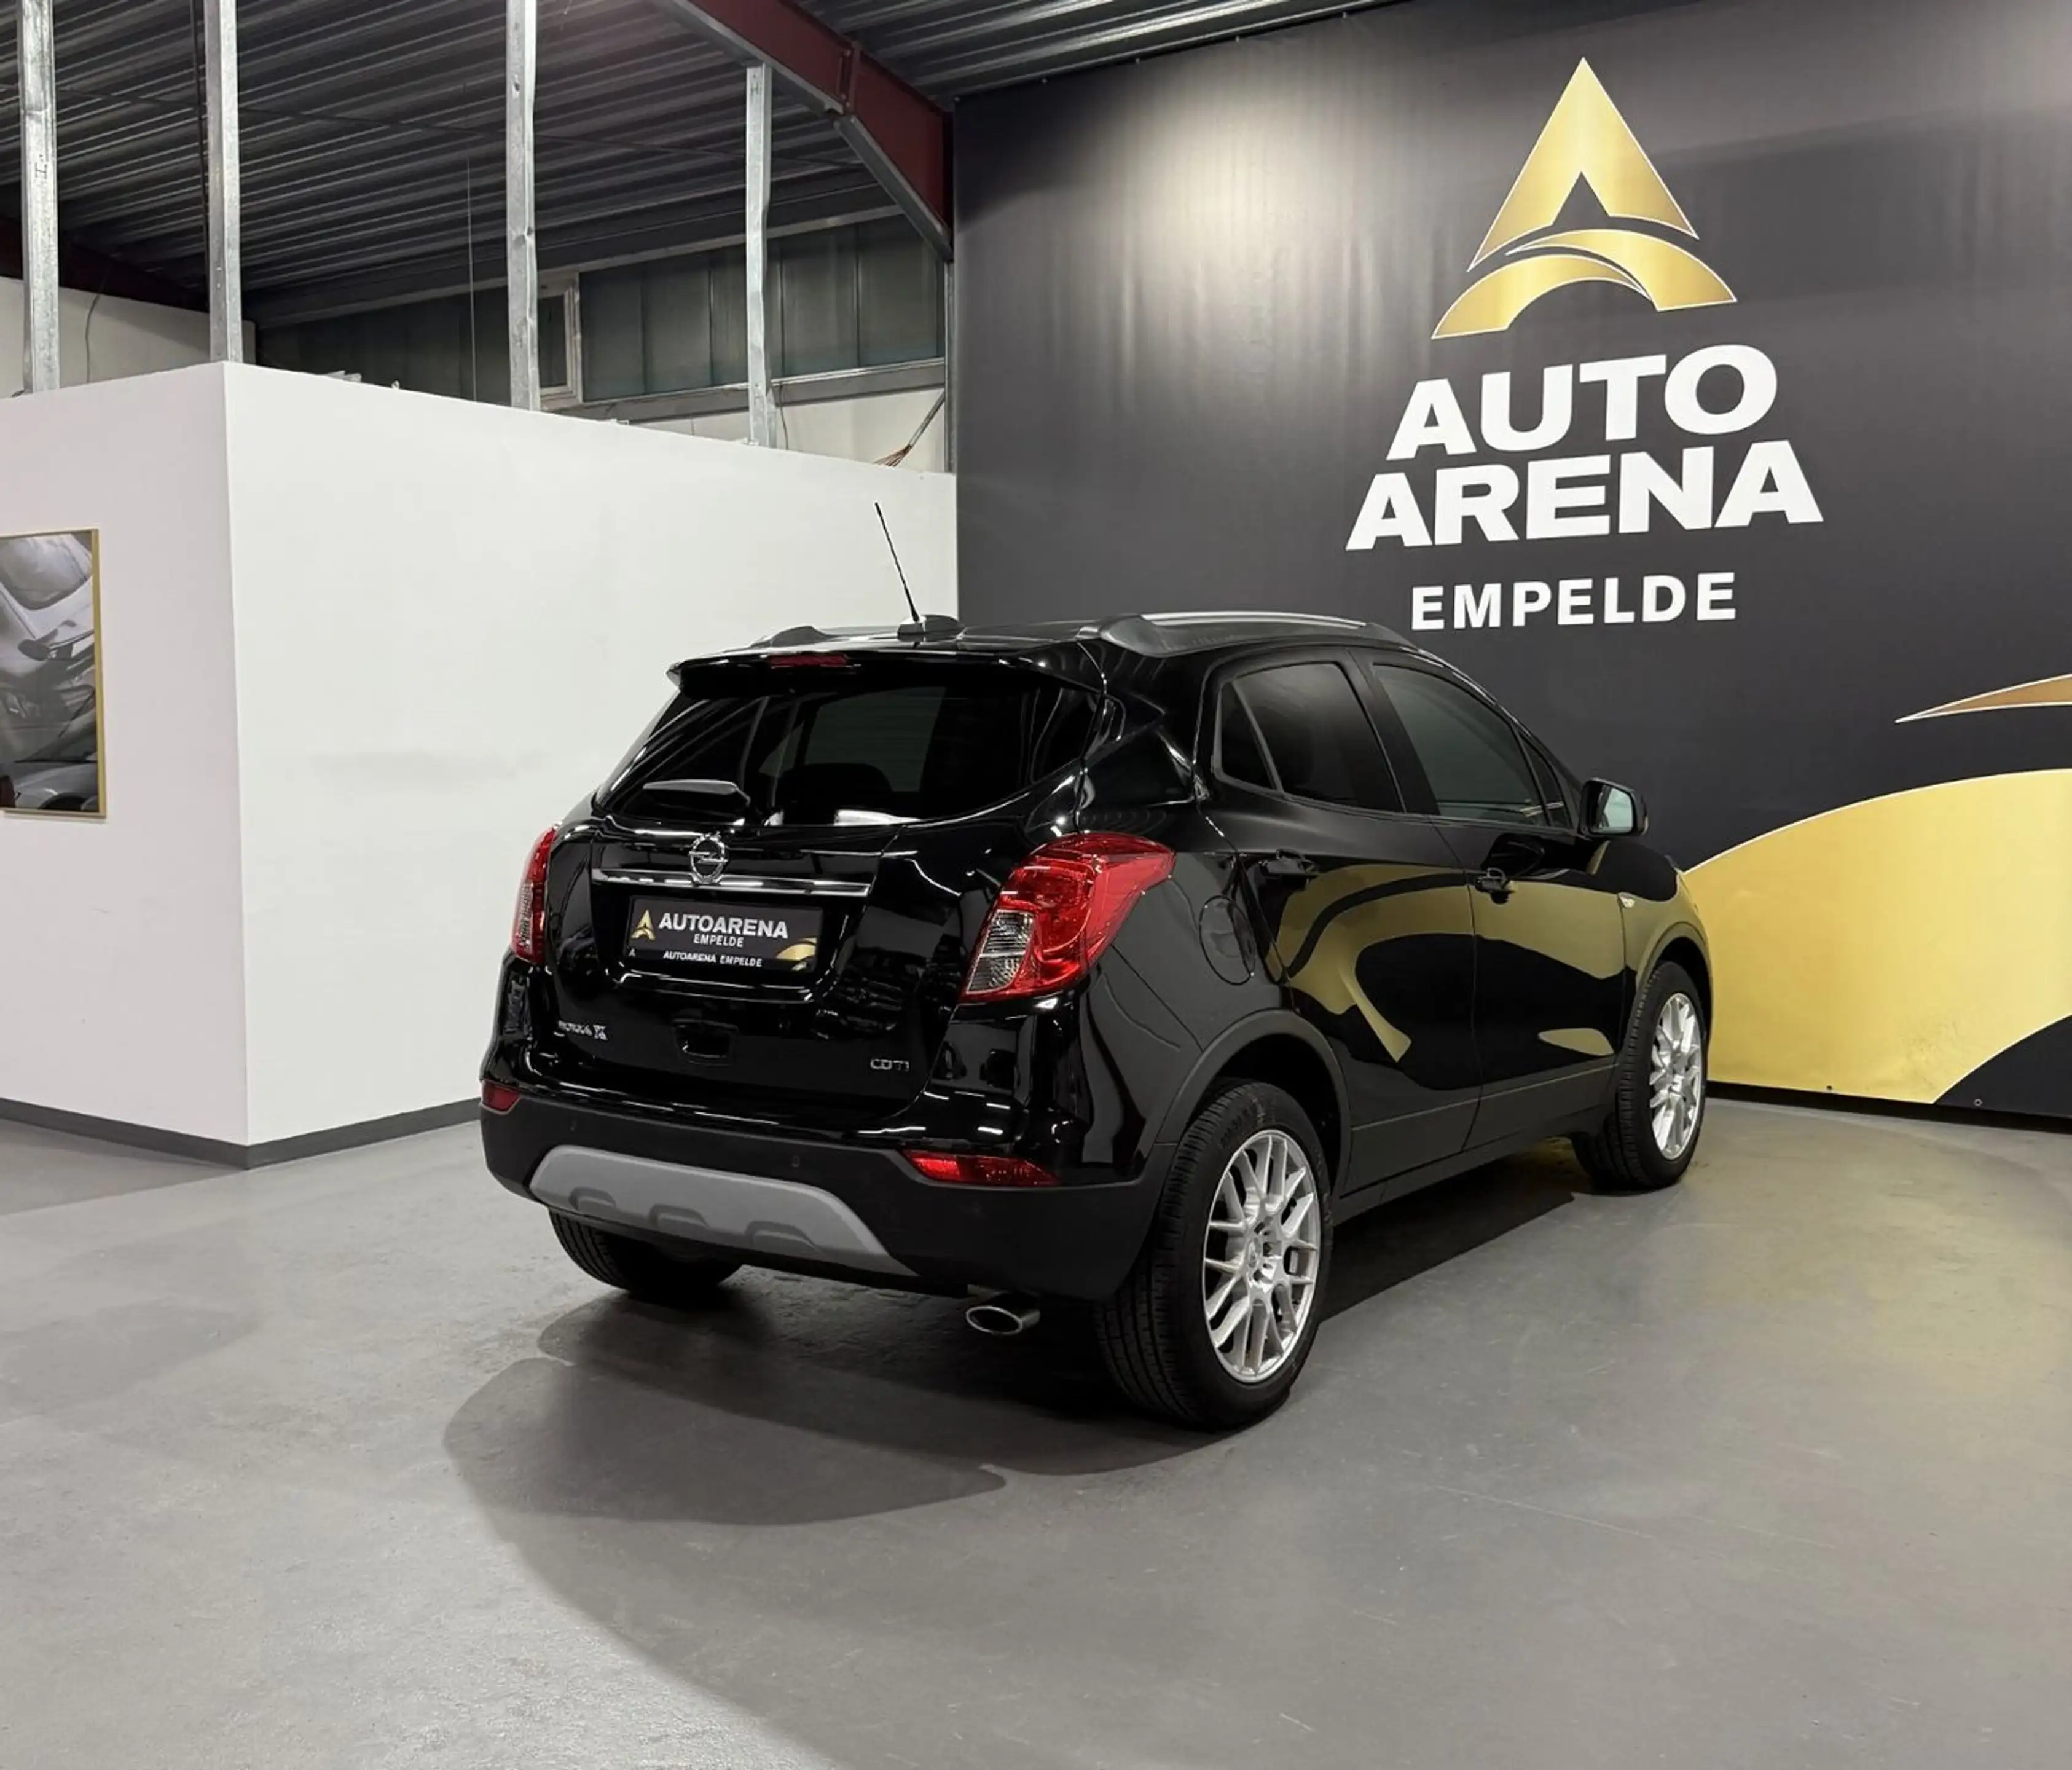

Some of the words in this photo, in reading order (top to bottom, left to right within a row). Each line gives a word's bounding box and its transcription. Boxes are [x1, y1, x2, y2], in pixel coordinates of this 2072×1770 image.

[1386, 344, 1778, 461] AUTO
[1345, 439, 1824, 551] ARENA
[1411, 572, 1736, 631] EMPELDE
[659, 912, 788, 939] AUTOARENA
[693, 934, 744, 947] EMPELDE
[662, 950, 716, 963] AUTOARENA
[720, 954, 763, 967] EMPELDE
